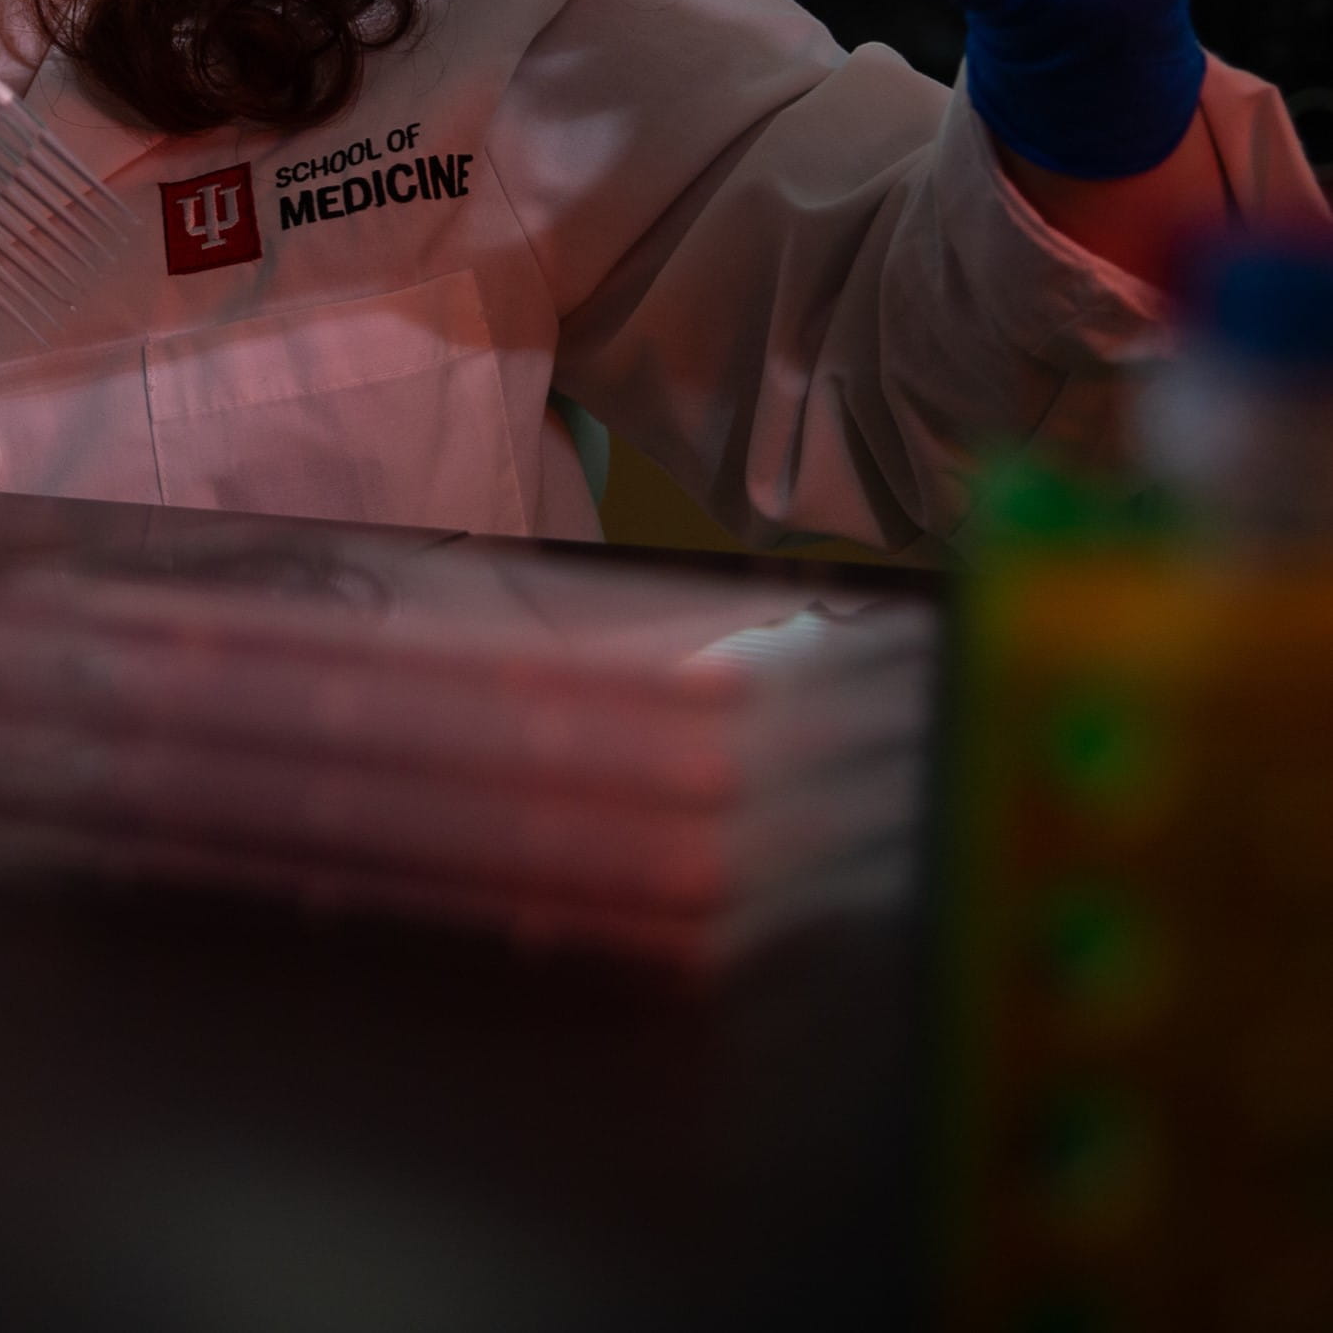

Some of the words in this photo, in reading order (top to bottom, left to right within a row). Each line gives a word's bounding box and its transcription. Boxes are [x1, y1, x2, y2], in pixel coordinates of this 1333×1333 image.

[274, 137, 382, 189] SCHOOL
[386, 122, 421, 153] OF
[278, 153, 474, 231] MEDICINE
